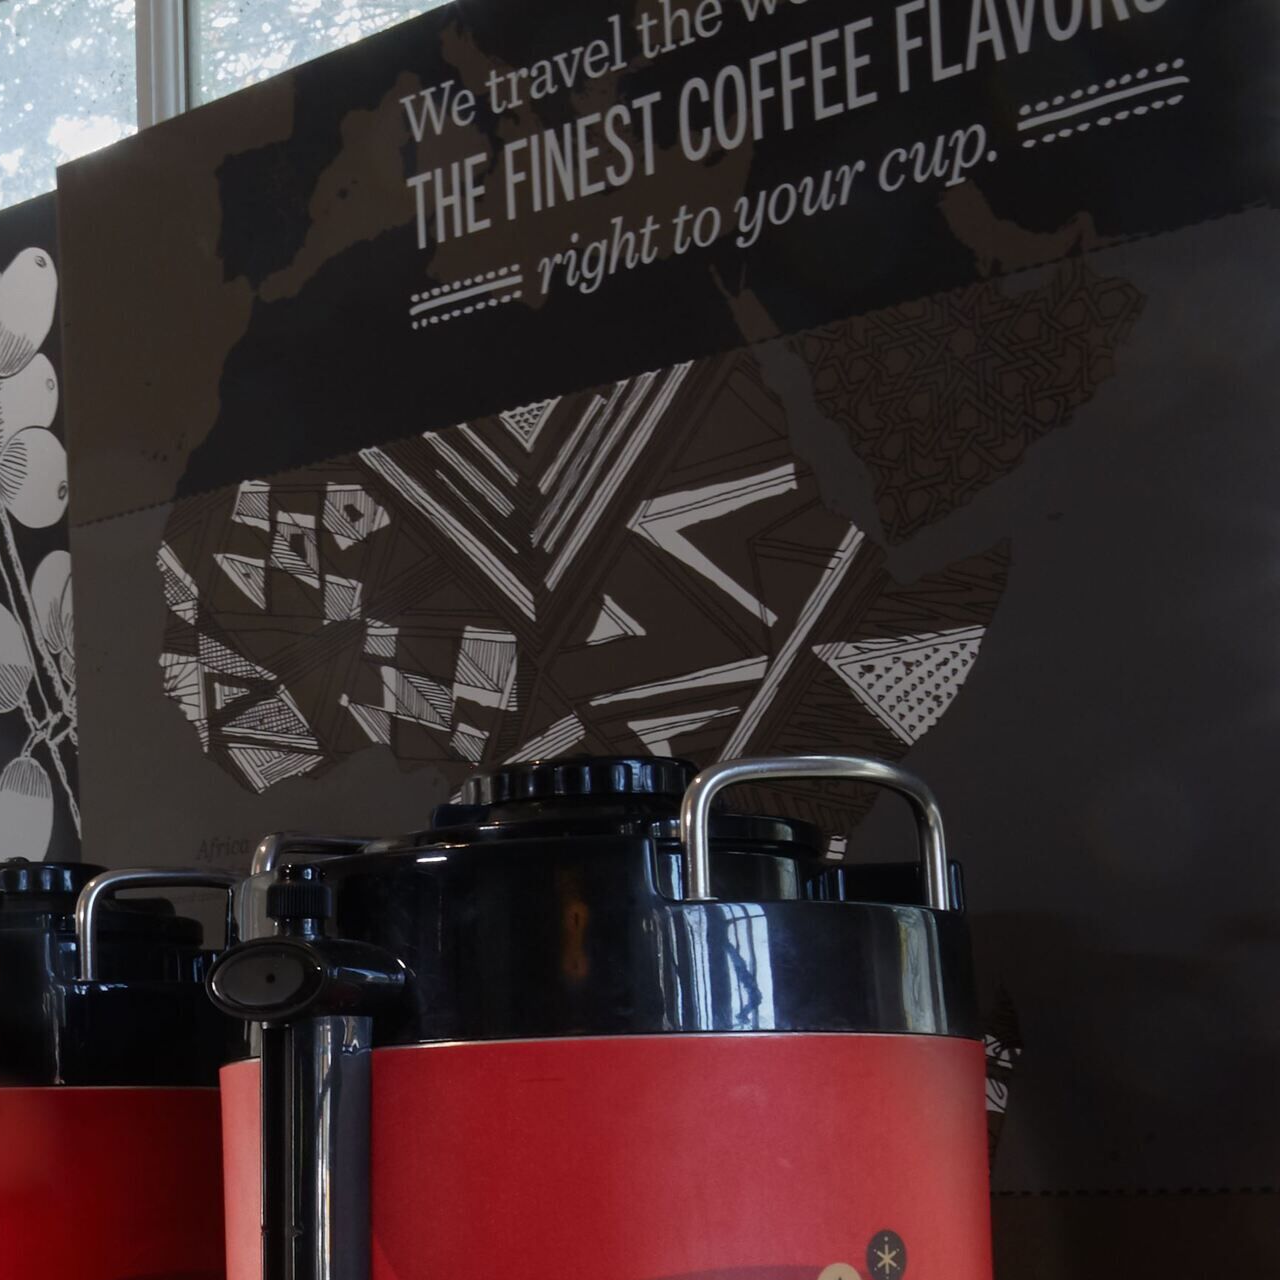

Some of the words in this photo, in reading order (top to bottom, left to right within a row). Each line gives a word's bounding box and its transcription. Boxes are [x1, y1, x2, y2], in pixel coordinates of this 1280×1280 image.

[400, 79, 478, 144] We
[485, 14, 627, 116] travel
[636, 0, 724, 60] the
[406, 154, 491, 250] THE
[504, 91, 662, 222] FINEST
[676, 17, 879, 162] COFFEE
[536, 214, 659, 296] right
[671, 207, 722, 256] to
[734, 163, 867, 250] your
[876, 122, 1000, 192] cup.
[196, 836, 249, 862] Africa
